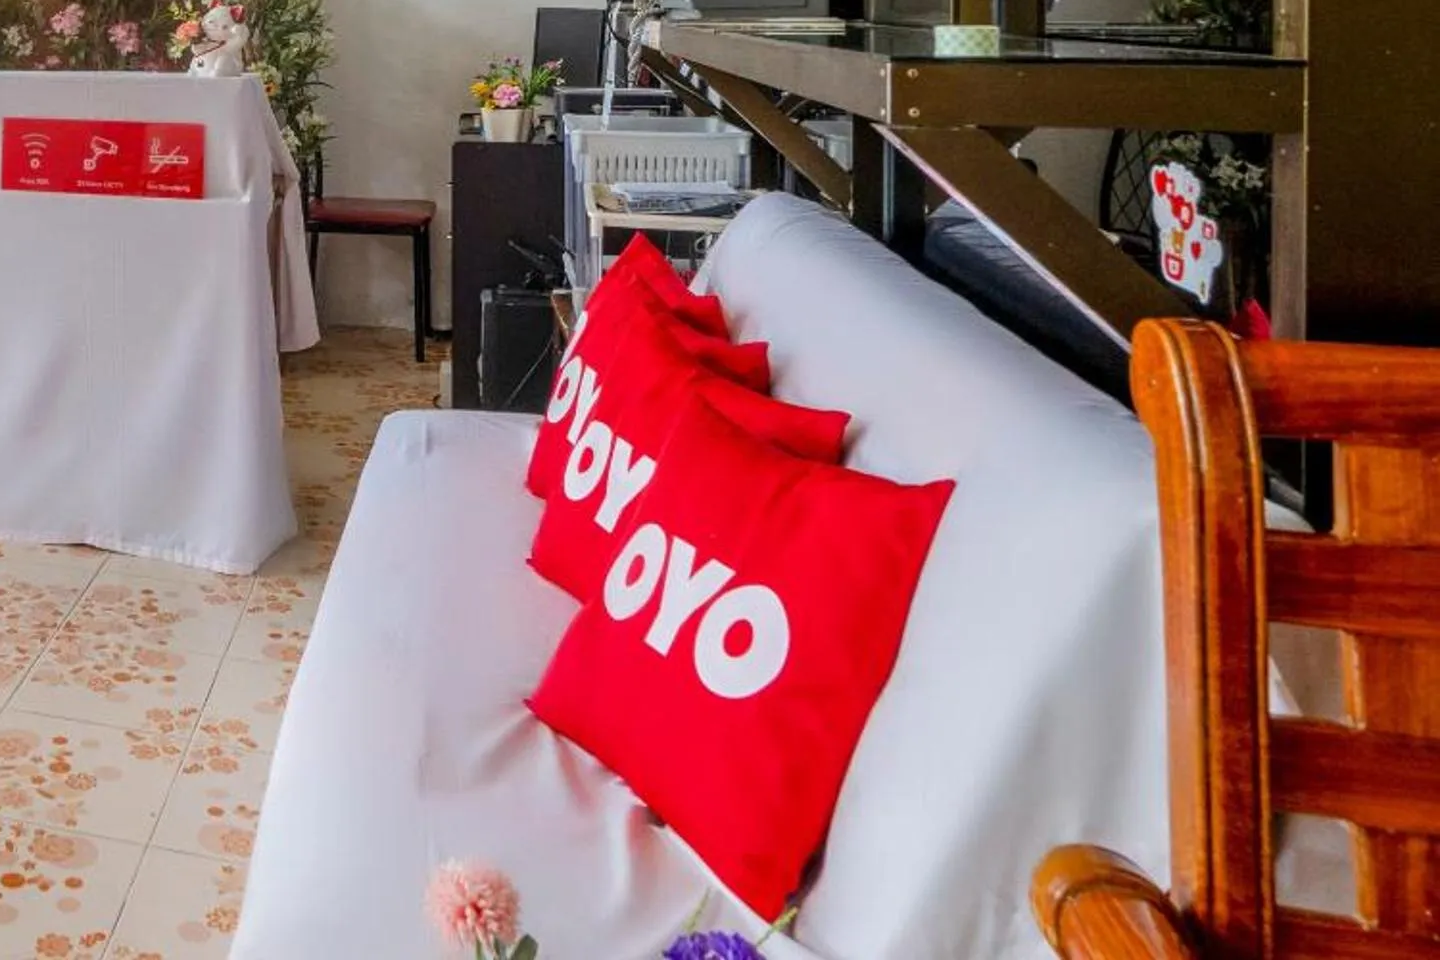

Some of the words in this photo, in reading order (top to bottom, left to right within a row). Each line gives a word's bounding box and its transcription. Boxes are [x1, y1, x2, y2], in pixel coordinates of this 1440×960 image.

[546, 356, 602, 445] OY
[563, 421, 657, 534] OY
[603, 522, 791, 699] OYO
